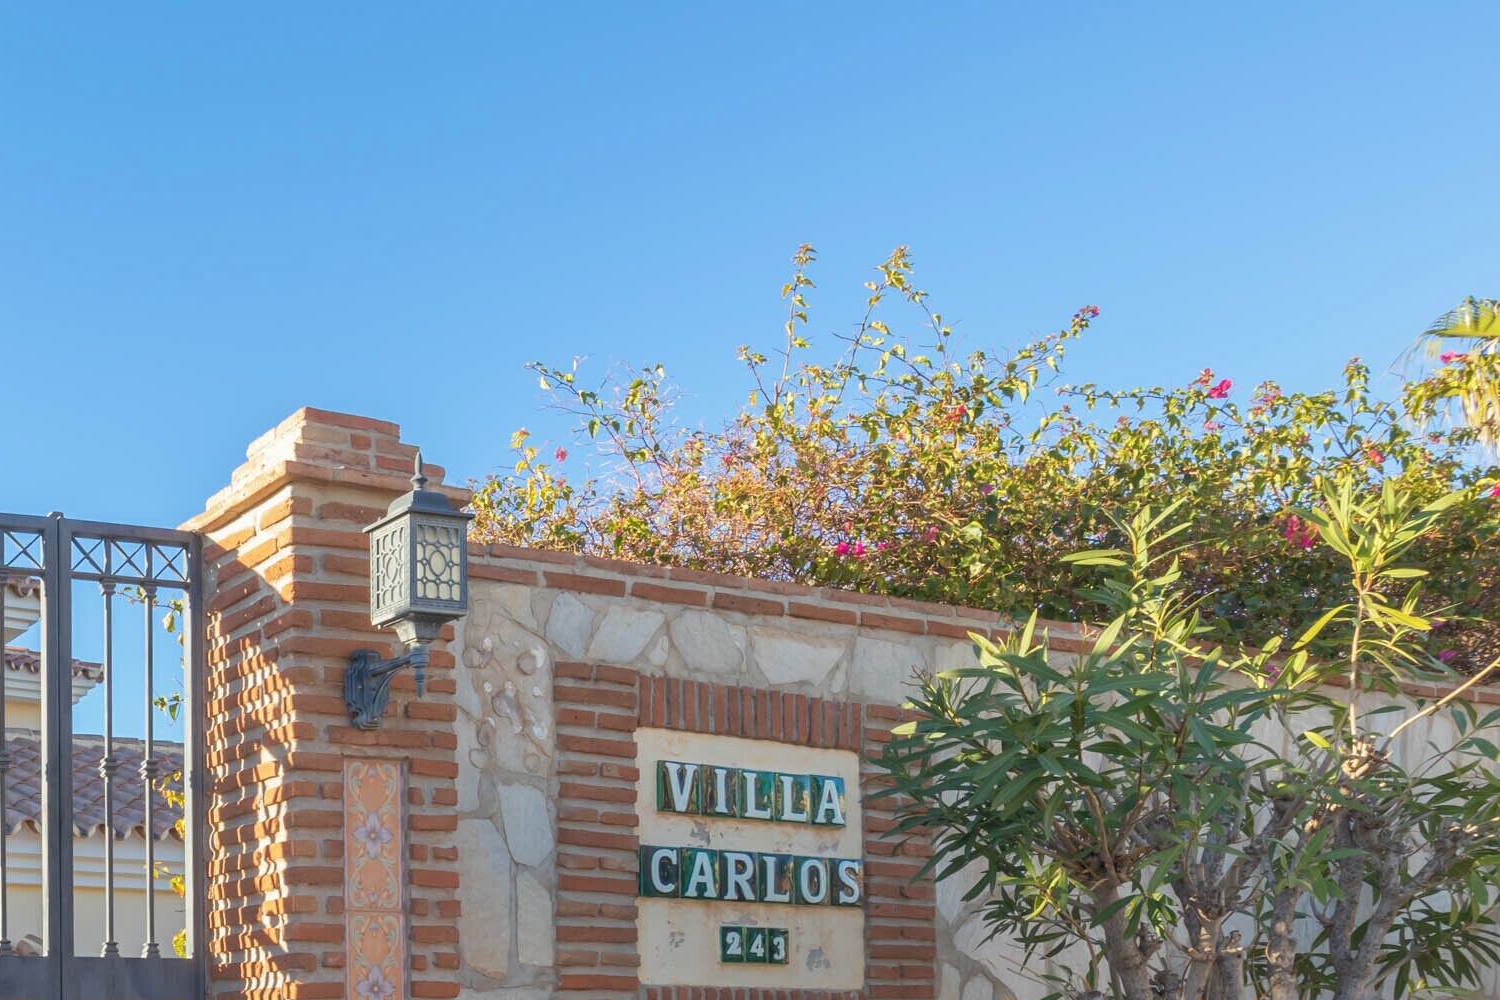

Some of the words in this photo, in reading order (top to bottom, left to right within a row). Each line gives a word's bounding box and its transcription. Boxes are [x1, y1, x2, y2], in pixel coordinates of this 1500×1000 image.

[663, 762, 844, 825] VILLA
[650, 848, 860, 904] CARLOS
[725, 931, 786, 961] 243
